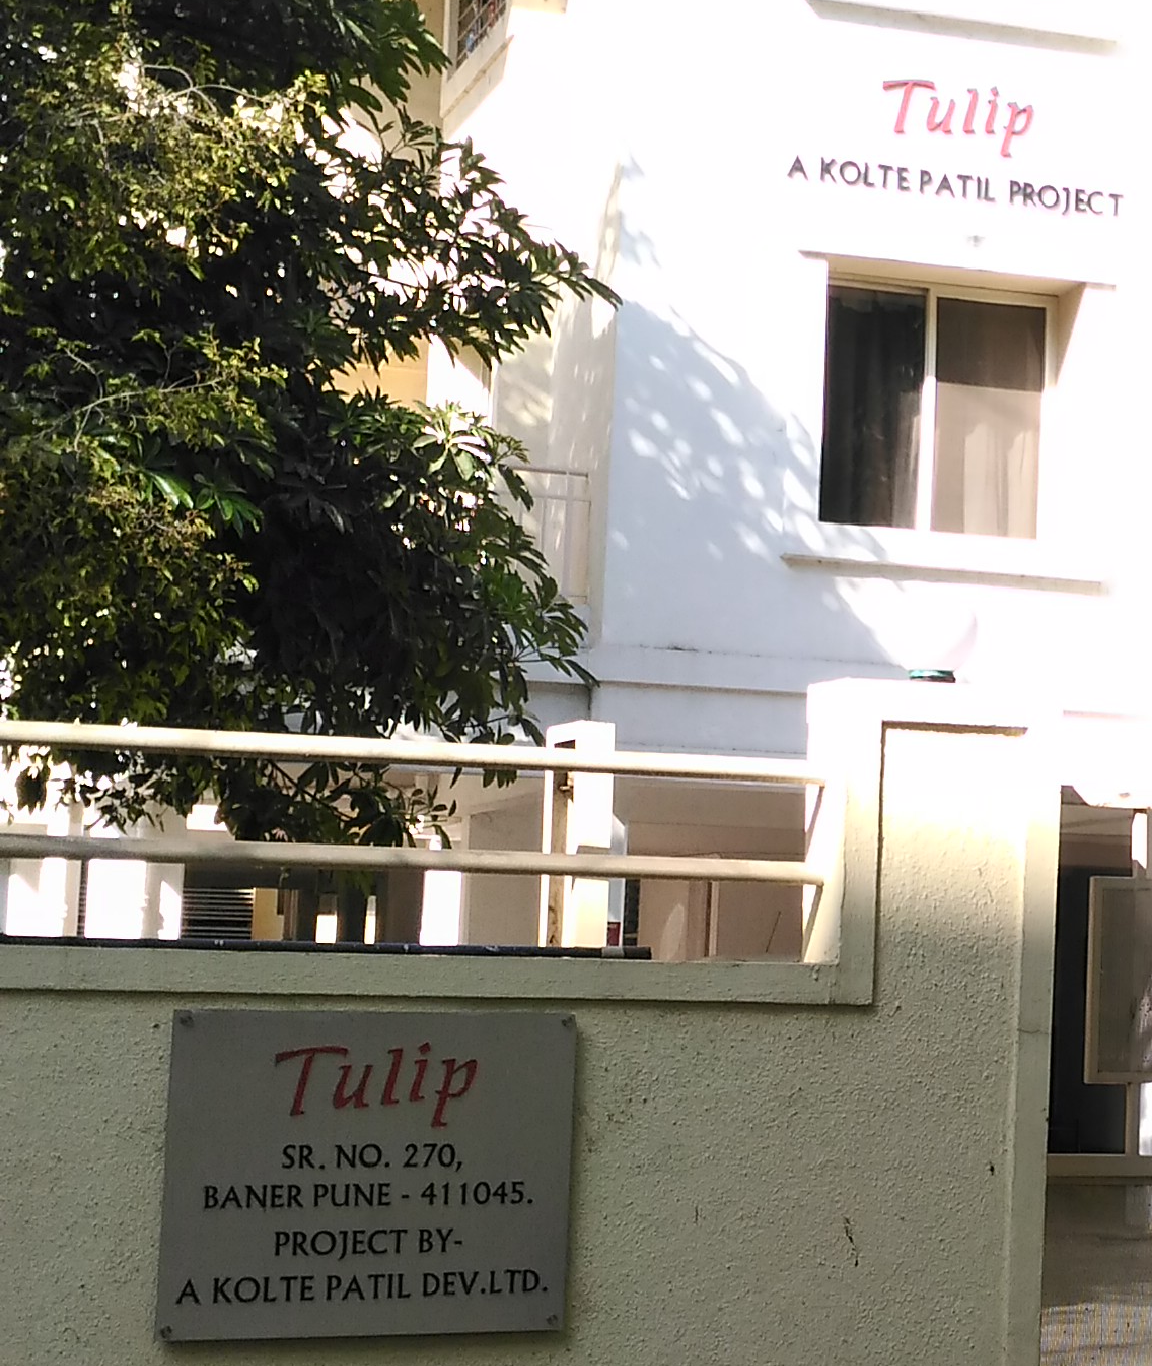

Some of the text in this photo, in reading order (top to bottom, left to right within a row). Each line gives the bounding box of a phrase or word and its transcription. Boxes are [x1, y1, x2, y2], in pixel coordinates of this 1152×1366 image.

[882, 78, 1035, 158] Tulip
[787, 155, 1125, 217] A KOLTE PATIL PROJECT
[274, 1041, 479, 1128] Tulip
[281, 1142, 464, 1173] SR. NO. 270,
[203, 1184, 304, 1211] BANER
[312, 1182, 392, 1208] PUNE
[420, 1180, 534, 1207] 411045.
[274, 1228, 463, 1262] PROJECT BY-
[175, 1278, 201, 1306] A
[212, 1275, 315, 1305] KOLTE
[326, 1272, 411, 1302] PATIL
